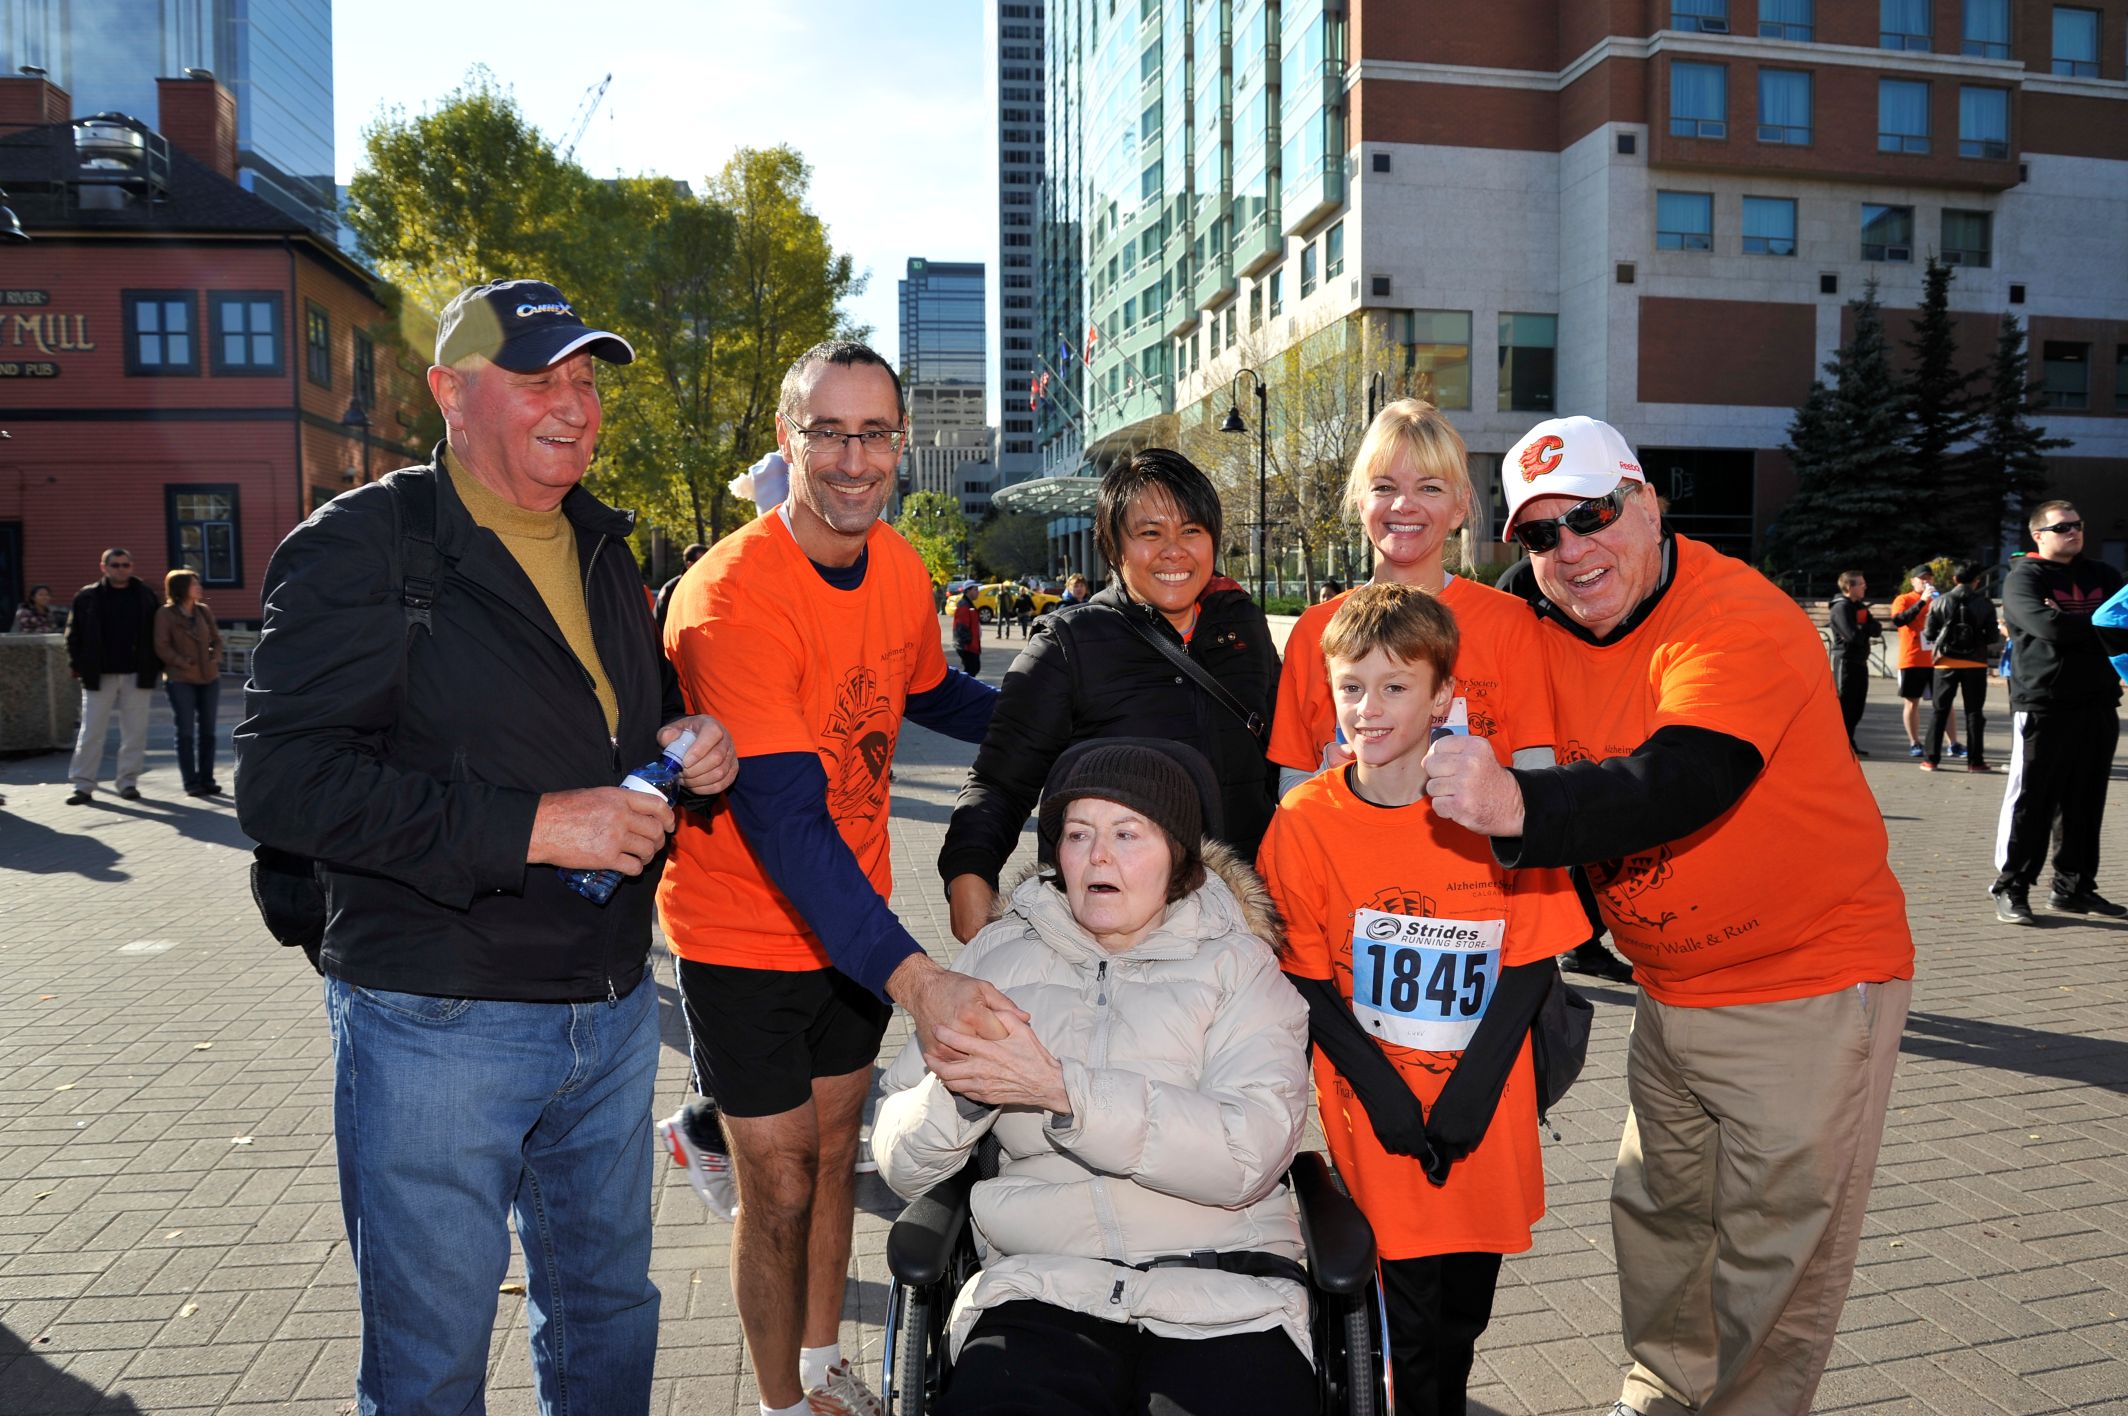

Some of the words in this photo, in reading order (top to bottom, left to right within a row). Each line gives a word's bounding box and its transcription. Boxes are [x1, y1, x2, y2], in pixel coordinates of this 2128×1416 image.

[6, 291, 42, 304] RIVER
[13, 314, 95, 355] MILL
[0, 363, 19, 376] ND
[25, 363, 53, 376] PUB
[1519, 435, 1564, 483] C
[1469, 679, 1498, 688] Society
[1446, 881, 1498, 892] Alzheimer
[1406, 922, 1479, 941] Strides
[1660, 937, 1703, 954] Walk
[1706, 934, 1722, 947] &
[1722, 919, 1760, 939] Run
[1401, 935, 1450, 947] RUNNING
[1455, 940, 1486, 948] STORE
[1367, 944, 1488, 1016] 1845
